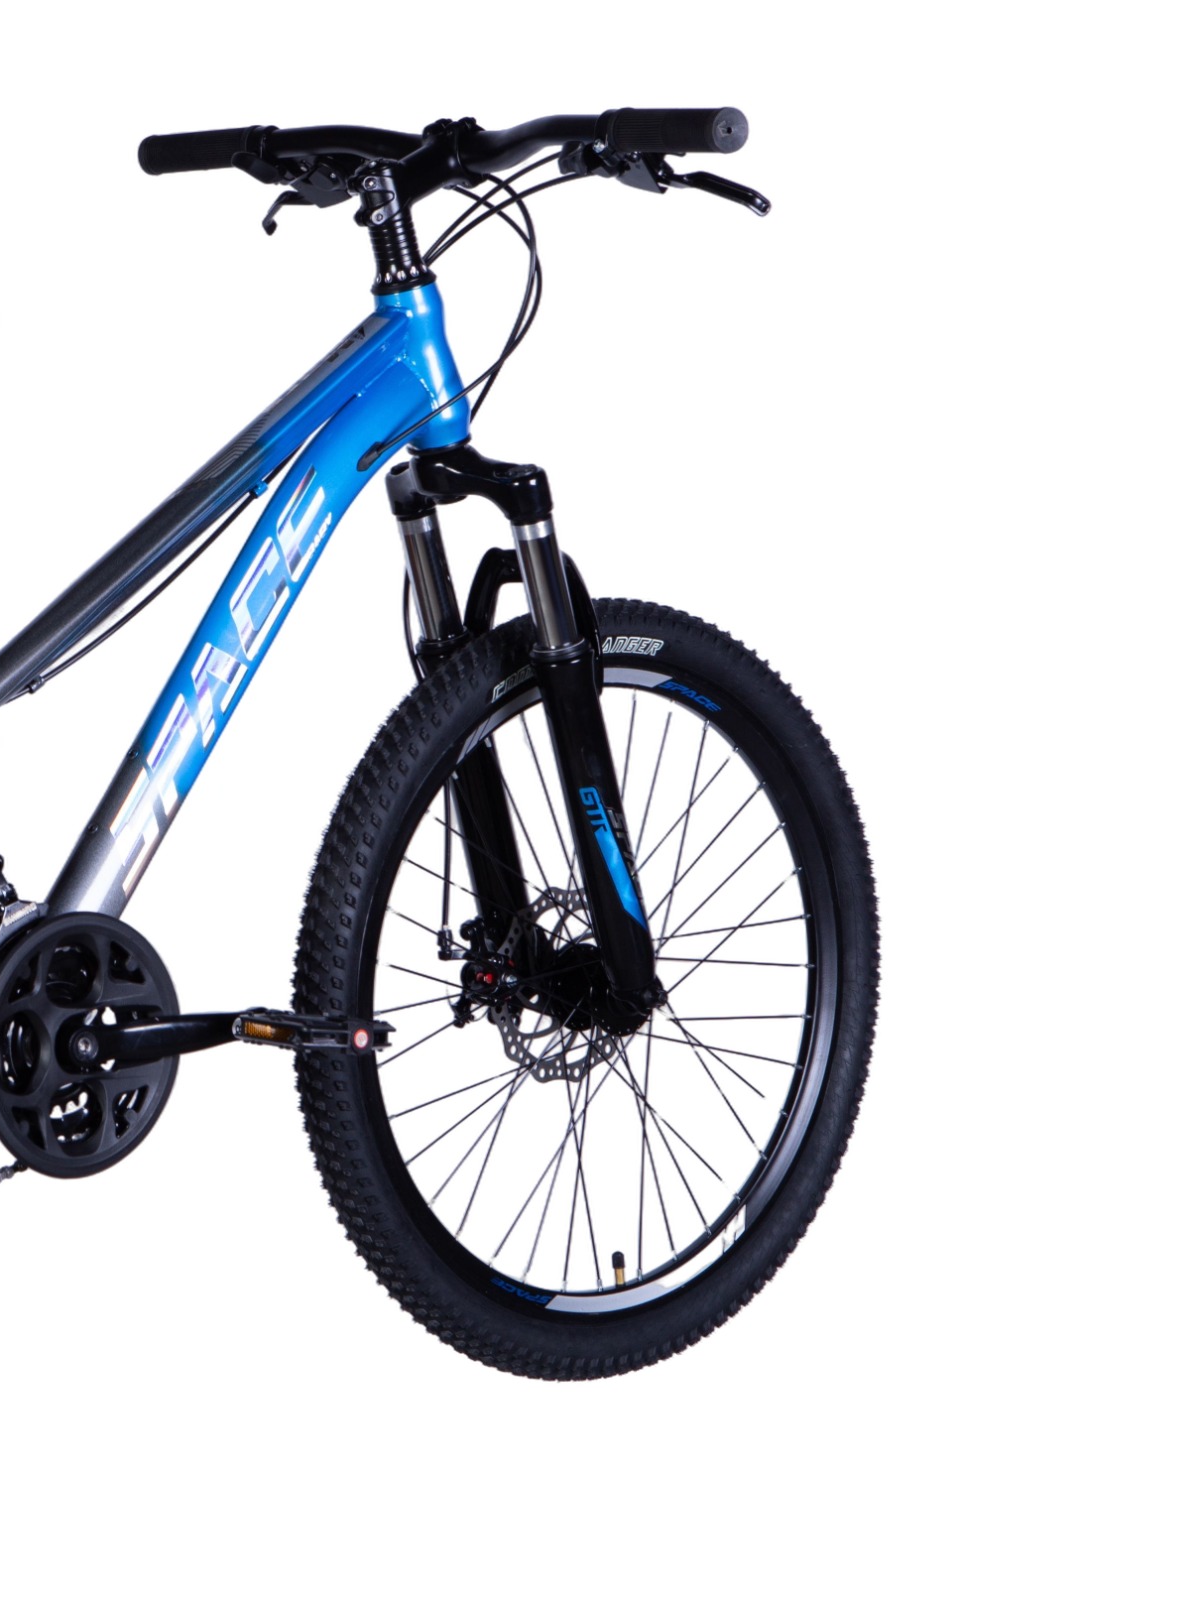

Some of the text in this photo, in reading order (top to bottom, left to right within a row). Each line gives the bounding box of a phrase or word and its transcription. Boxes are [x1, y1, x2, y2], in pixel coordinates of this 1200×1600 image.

[601, 636, 664, 656] ANGER
[109, 465, 325, 898] SPACE
[661, 681, 722, 712] SPACE
[491, 1277, 550, 1303] SPACE
